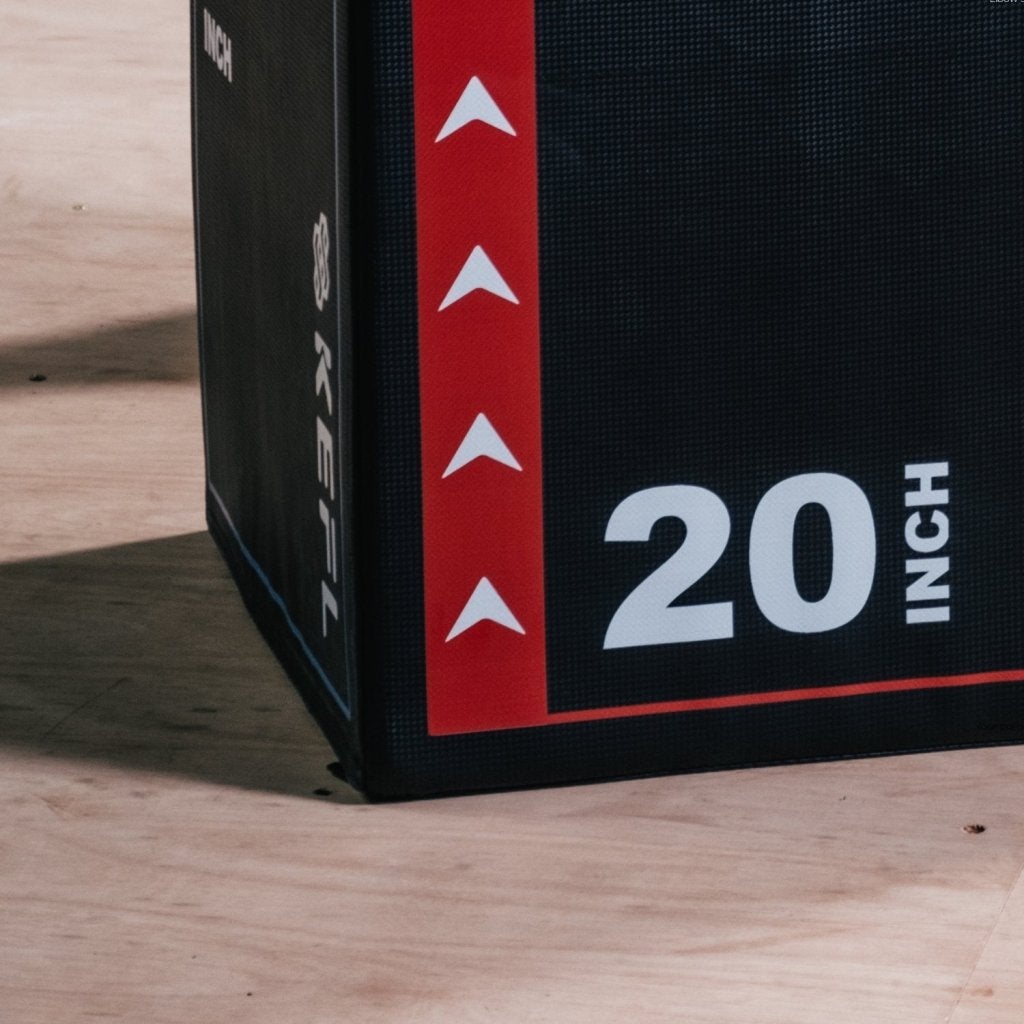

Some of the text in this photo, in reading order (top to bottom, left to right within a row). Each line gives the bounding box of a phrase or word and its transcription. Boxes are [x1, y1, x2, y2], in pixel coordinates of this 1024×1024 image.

[203, 8, 233, 84] INCH
[314, 331, 338, 638] KEFL
[602, 472, 877, 650] 20
[904, 461, 951, 625] INCH
